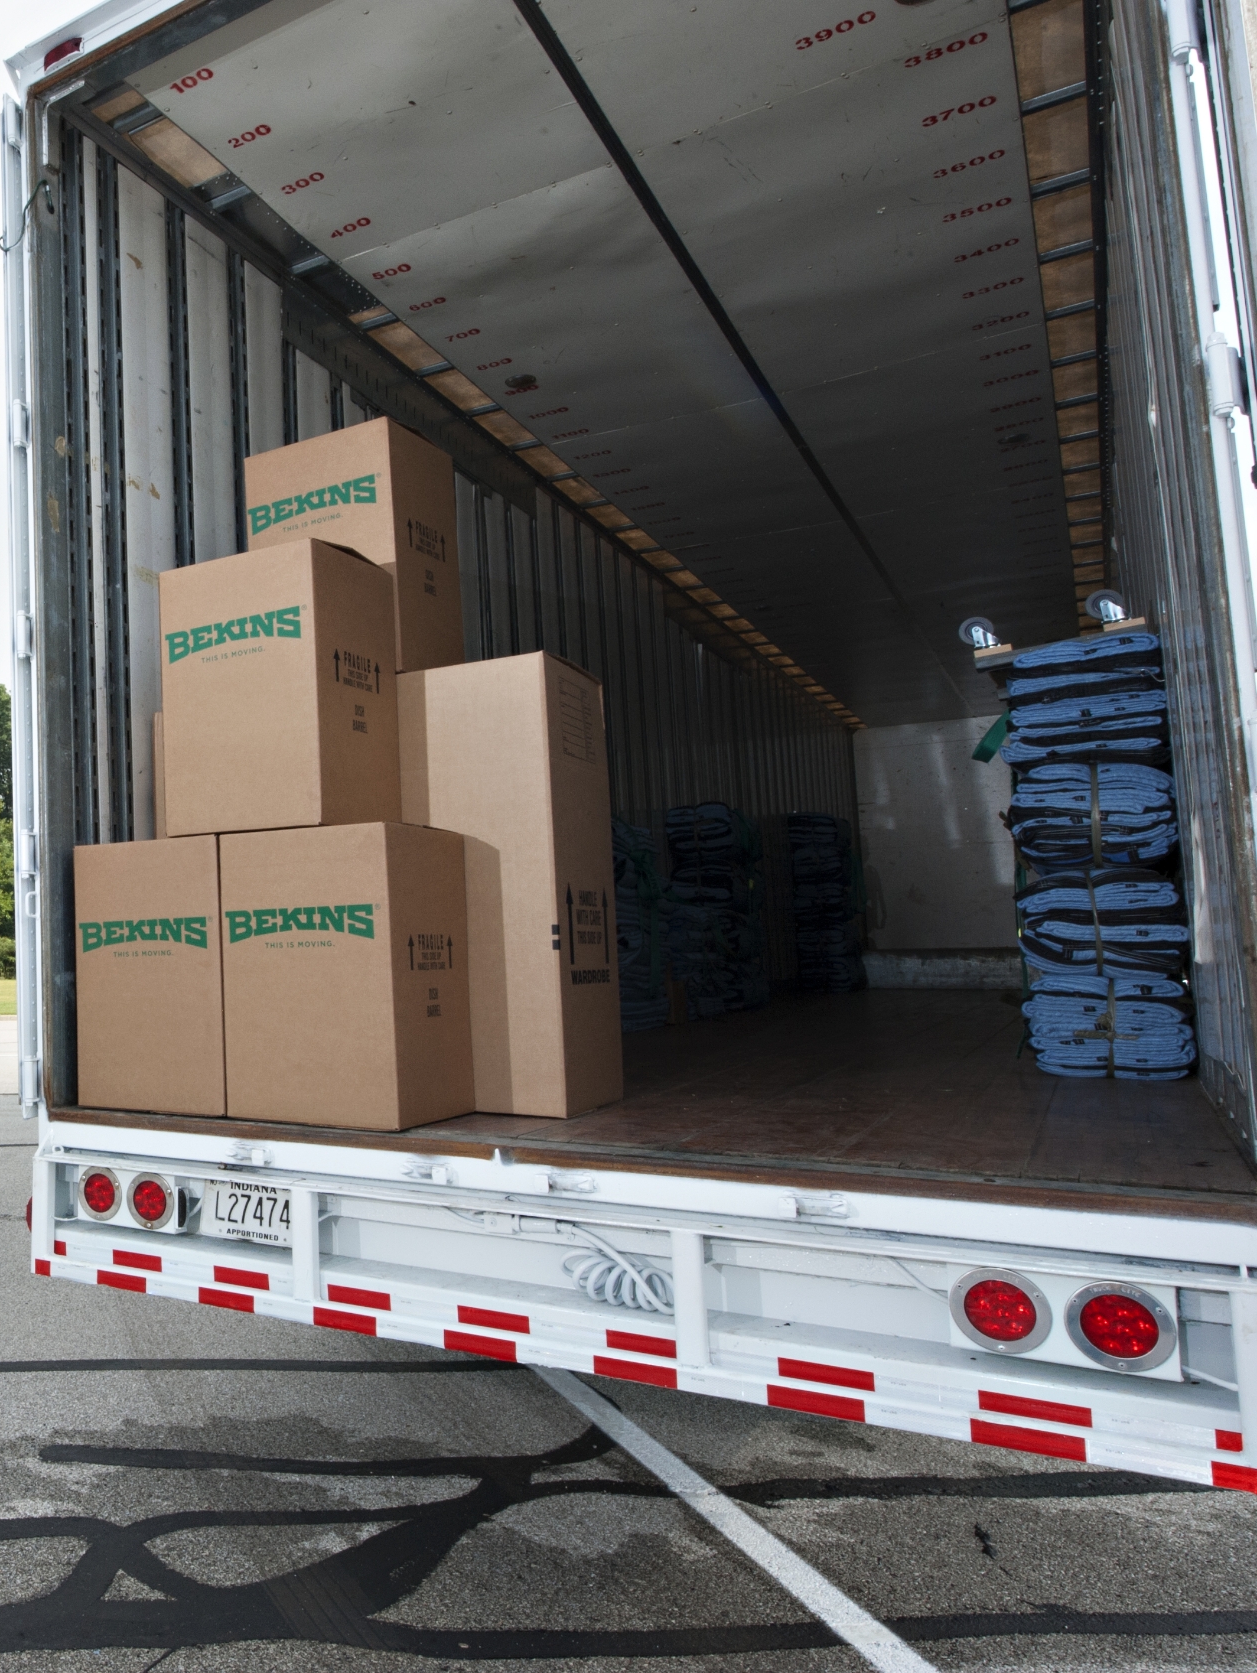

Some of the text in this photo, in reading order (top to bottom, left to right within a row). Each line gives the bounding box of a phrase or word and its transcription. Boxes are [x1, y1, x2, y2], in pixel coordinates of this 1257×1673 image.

[796, 11, 876, 50] 3900
[905, 32, 988, 68] 3800
[170, 68, 214, 94] 100
[922, 95, 997, 127] 3700
[228, 124, 272, 149] 200
[933, 149, 1006, 179] 3600
[281, 171, 325, 195] 300
[943, 197, 1012, 223] 3500
[331, 217, 371, 238] 400
[954, 237, 1020, 263] 3400
[372, 263, 412, 280] 500
[962, 276, 1024, 300] 3300
[409, 296, 447, 312] 600
[972, 311, 1030, 331] 3200
[445, 328, 481, 343] 700
[979, 343, 1032, 361] 3100
[476, 357, 513, 371] 800
[983, 369, 1040, 387] 3000
[530, 407, 569, 419] 1000
[991, 397, 1041, 413] 2900
[553, 429, 589, 439] 1100
[575, 449, 612, 460] 1200
[248, 474, 376, 535] BEKINS
[282, 524, 299, 533] THIS
[301, 520, 308, 528] IS
[415, 520, 438, 543] FRAGILE
[165, 605, 301, 664] BEKINS
[201, 655, 218, 664] THIS
[231, 646, 265, 658] MOVING.
[344, 651, 371, 674] FRAGILE
[578, 890, 597, 907] HANDLE
[224, 903, 375, 944] BEKINS
[576, 909, 601, 926] WITH CARE
[79, 916, 208, 953] BEKINS
[418, 934, 444, 950] FRAGILE
[577, 931, 602, 944] THIS SIDE UP
[297, 940, 335, 948] MOVING.
[571, 969, 610, 985] WARDROBE
[230, 1181, 277, 1195] INDIANA
[215, 1190, 291, 1230] L27474
[226, 1228, 279, 1242] APPORTIONED
